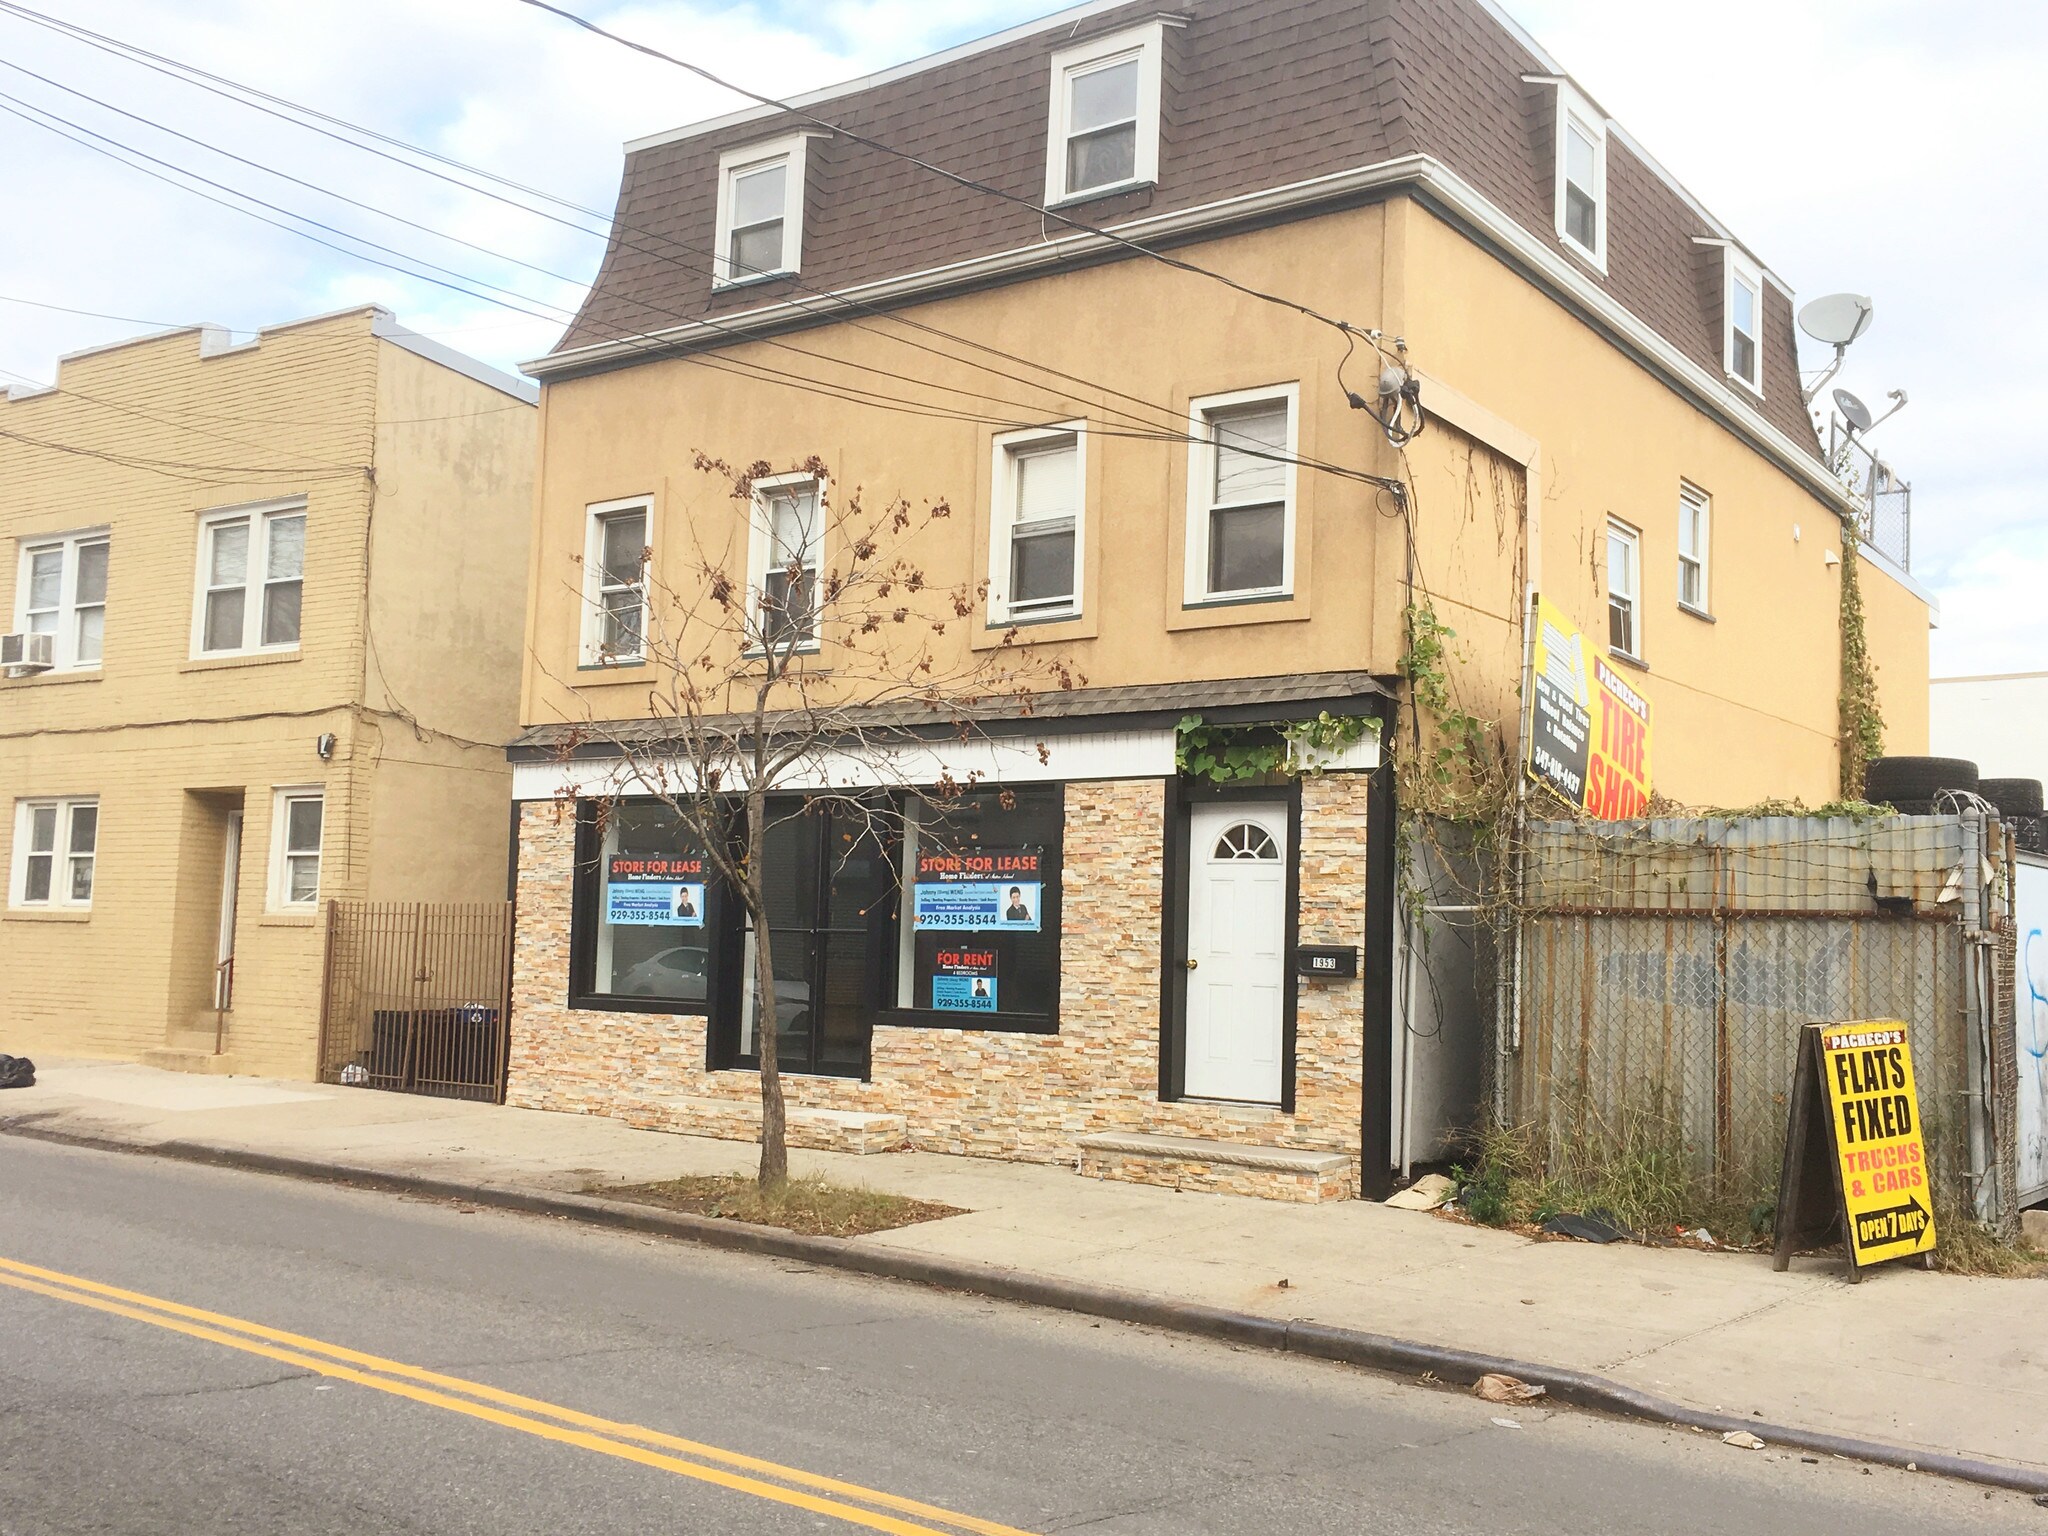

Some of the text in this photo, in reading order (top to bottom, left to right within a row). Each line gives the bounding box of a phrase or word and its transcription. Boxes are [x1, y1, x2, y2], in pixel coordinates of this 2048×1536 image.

[1599, 662, 1647, 720] PACHECO'S
[1540, 695, 1585, 742] Wheel Balance
[1551, 690, 1557, 702] &
[1558, 693, 1573, 715] Used
[1575, 706, 1590, 729] Tires
[1546, 720, 1577, 754] & Rotation
[1600, 687, 1646, 785] TIRE
[612, 860, 702, 874] STORE FOR LEASE
[920, 856, 1037, 872] STORE FOR LEASE
[939, 872, 958, 880] Home
[611, 910, 670, 921] 929-355-8544
[920, 914, 997, 925] 929-355-8544
[962, 904, 981, 912] Analysis
[937, 951, 993, 966] FOR RENT
[1315, 958, 1335, 968] 1953
[937, 998, 992, 1009] 929-355-8544
[1831, 1031, 1903, 1049] PACHECO'S
[1834, 1047, 1906, 1096] FLATS
[1842, 1094, 1912, 1144] FIXED
[1845, 1142, 1921, 1174] TRUCKS
[1851, 1166, 1922, 1199] & CARS
[1859, 1208, 1925, 1242] OPEN 7 DAYS
